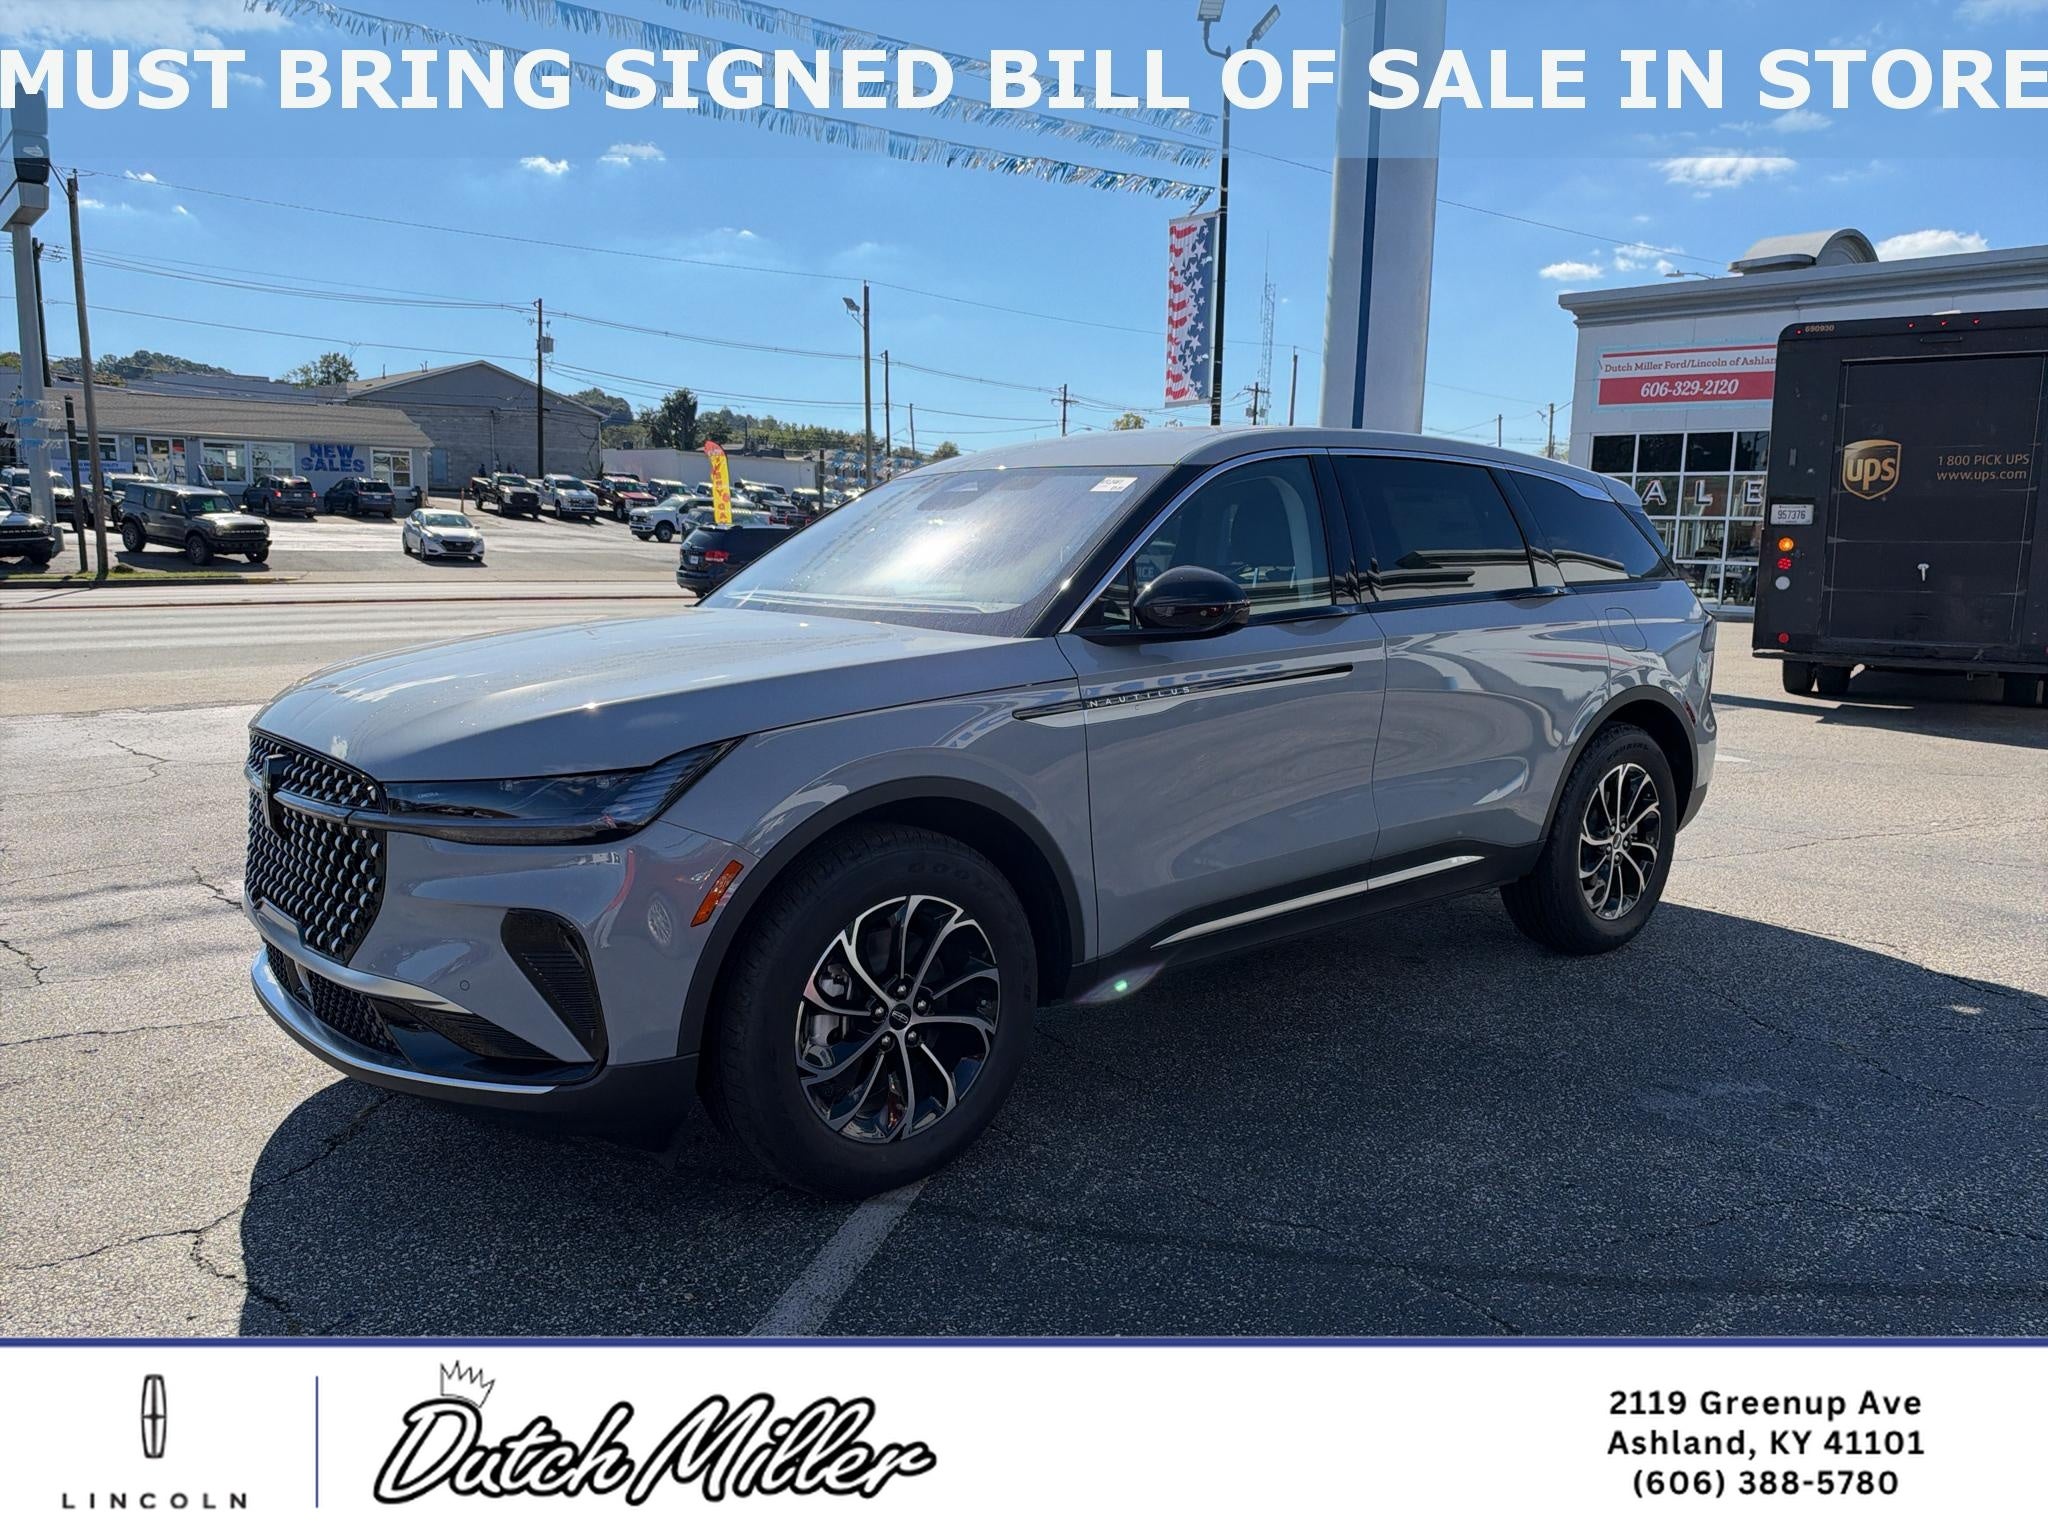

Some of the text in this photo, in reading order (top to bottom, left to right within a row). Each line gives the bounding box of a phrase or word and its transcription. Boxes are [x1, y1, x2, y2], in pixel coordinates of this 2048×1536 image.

[1604, 362, 1633, 372] Dutch
[1634, 361, 1663, 371] Miller
[1664, 358, 1727, 369] Ford/Lincoln
[1729, 357, 1741, 366] of
[1640, 379, 1739, 397] 606-329-2120
[309, 443, 355, 458] NEW
[301, 458, 365, 472] SALES
[1938, 453, 2030, 466] 1 800 PICK UPS
[1846, 457, 1897, 491] ups
[1936, 470, 2027, 482] www.ups.com
[1089, 686, 1191, 708] NAUTILUS
